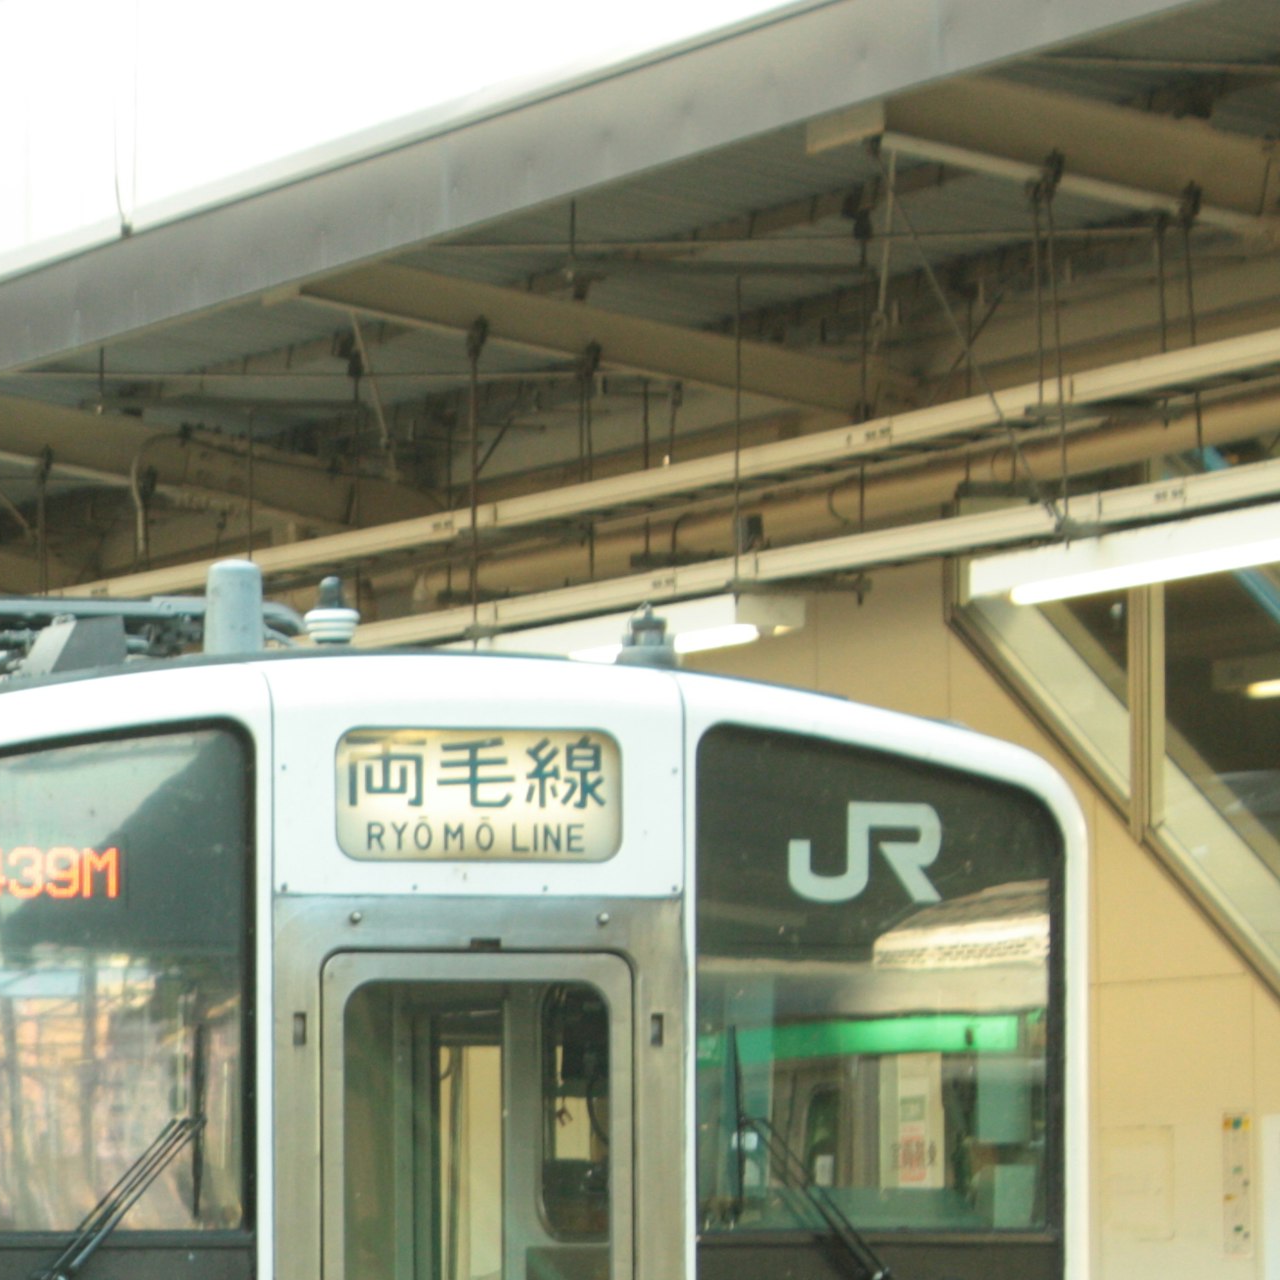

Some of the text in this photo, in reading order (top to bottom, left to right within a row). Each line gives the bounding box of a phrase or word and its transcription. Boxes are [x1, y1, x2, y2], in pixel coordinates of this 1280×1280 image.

[345, 735, 606, 808] 両毛線
[511, 822, 586, 852] LINE
[787, 800, 943, 904] JR
